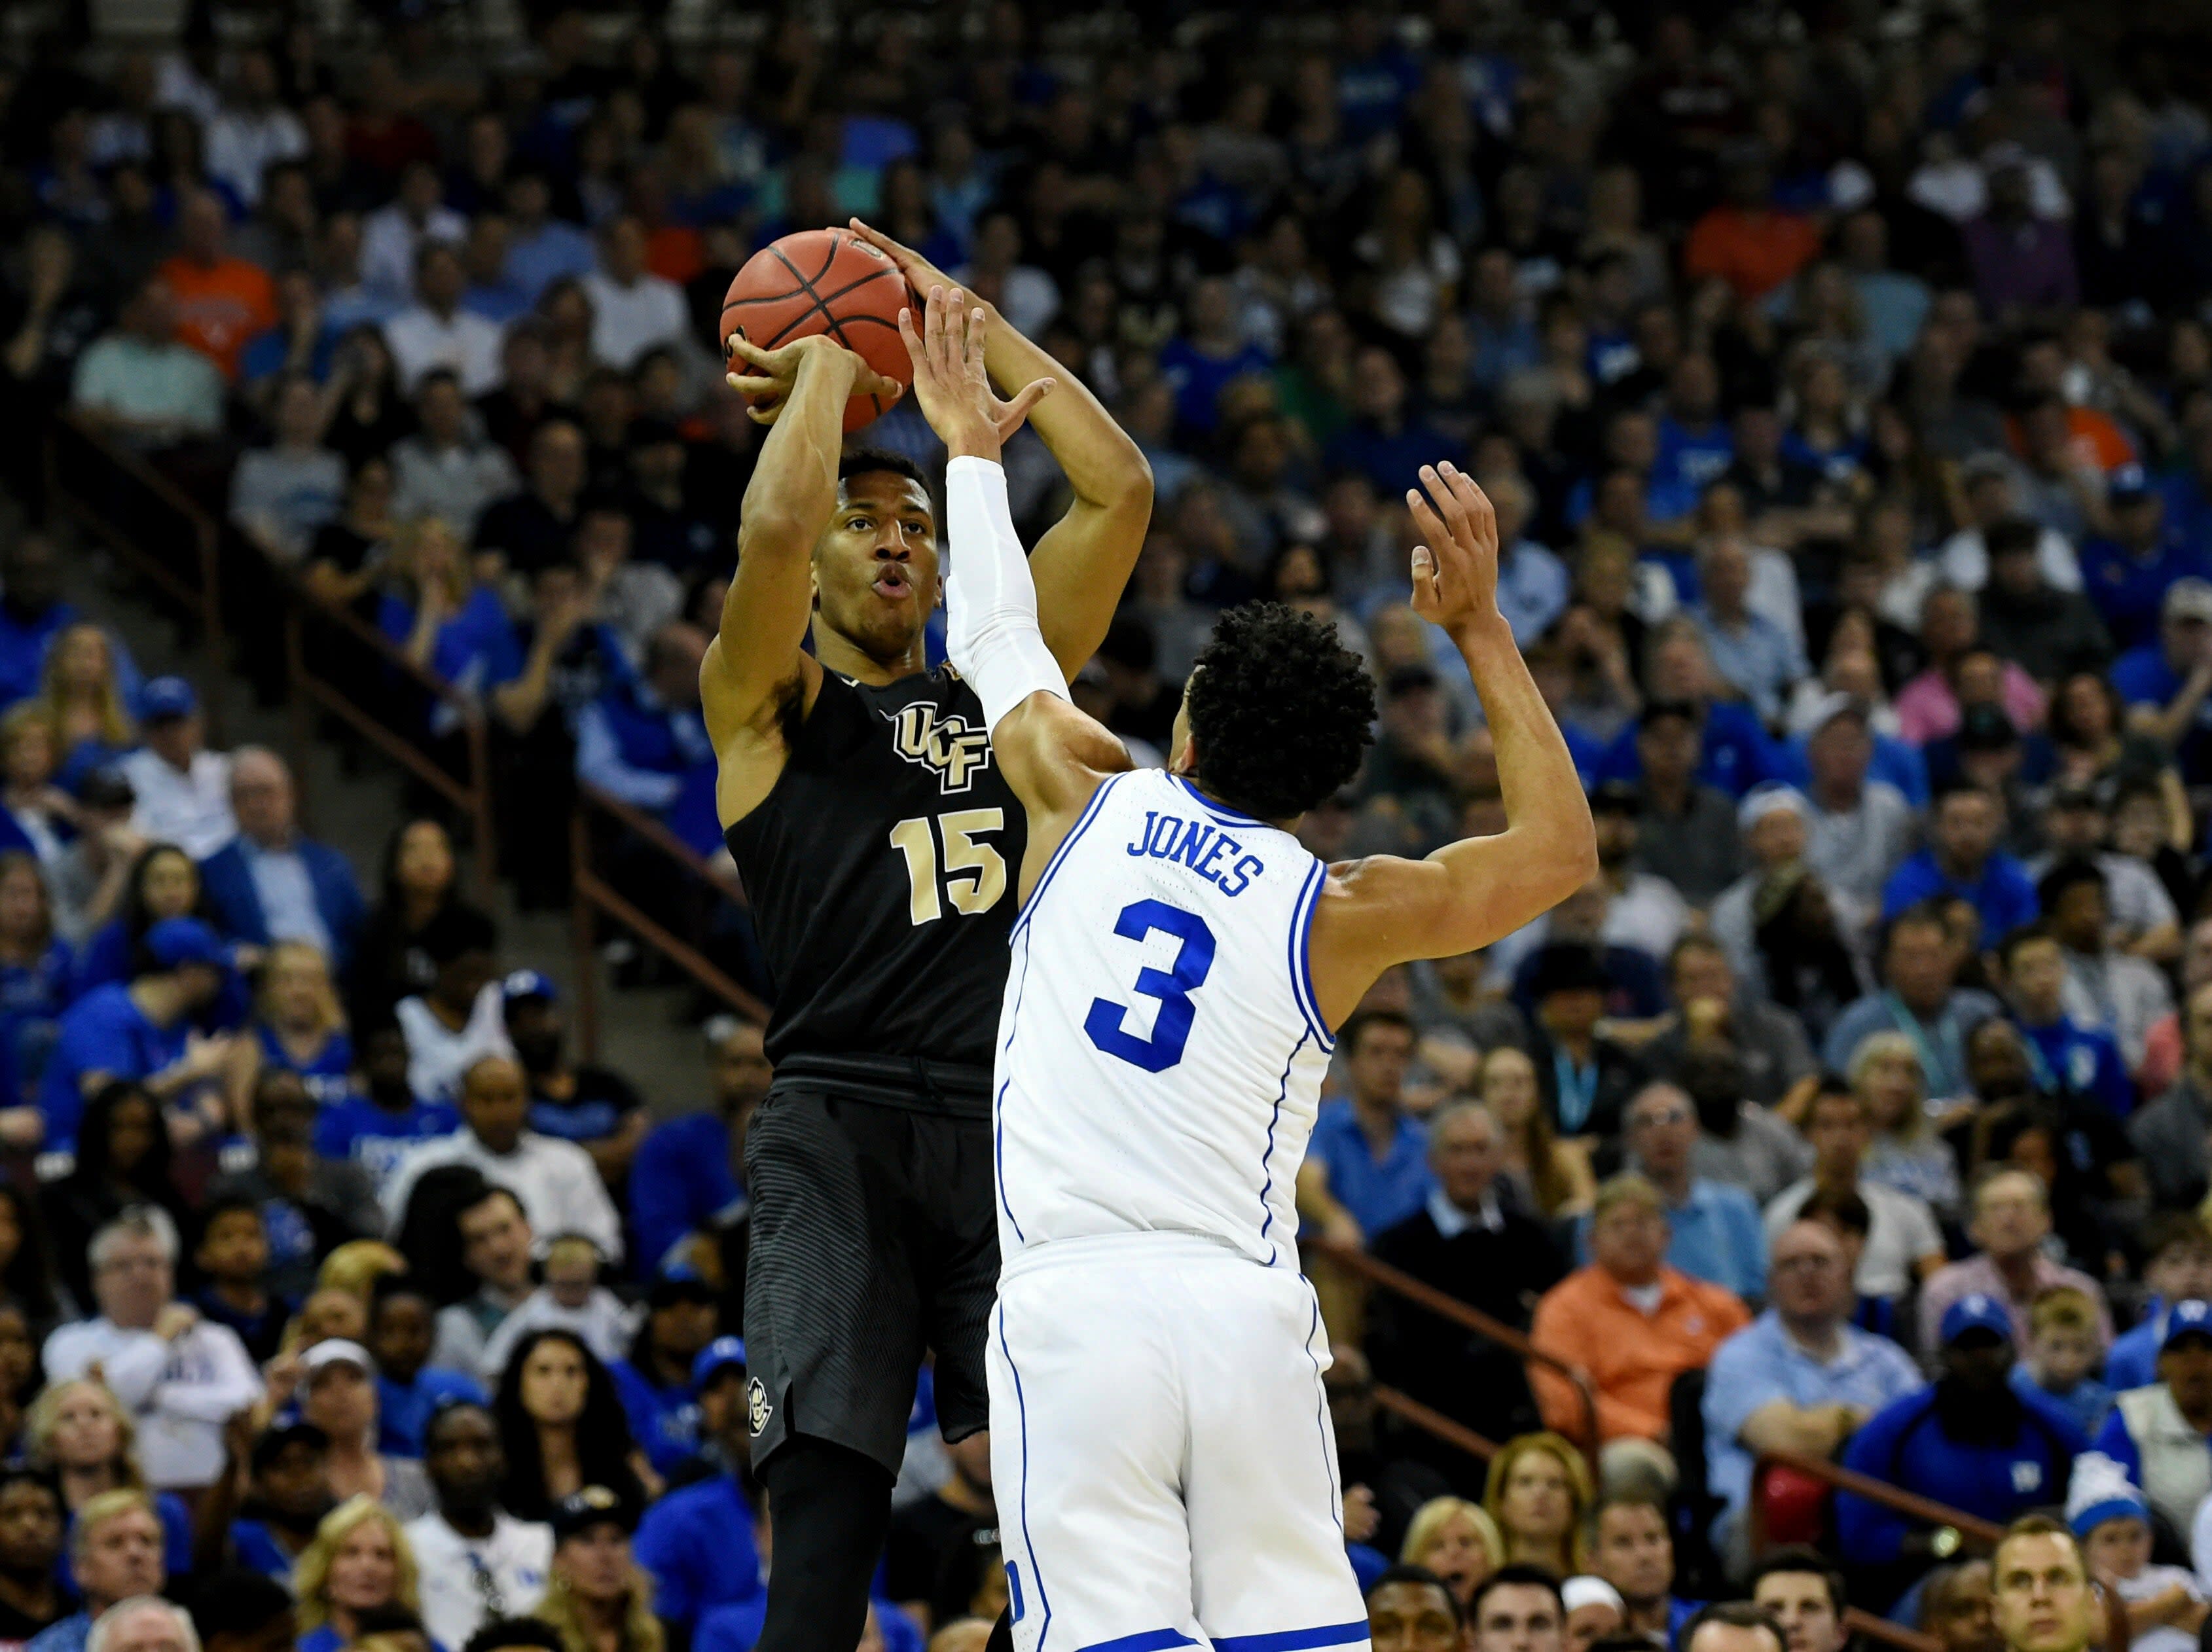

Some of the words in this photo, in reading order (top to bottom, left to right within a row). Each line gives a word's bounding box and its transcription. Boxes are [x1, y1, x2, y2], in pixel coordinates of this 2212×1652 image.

[894, 703, 990, 791] UCF
[890, 807, 1007, 926] 15
[1127, 811, 1264, 897] JONES
[1083, 898, 1217, 1073] 3
